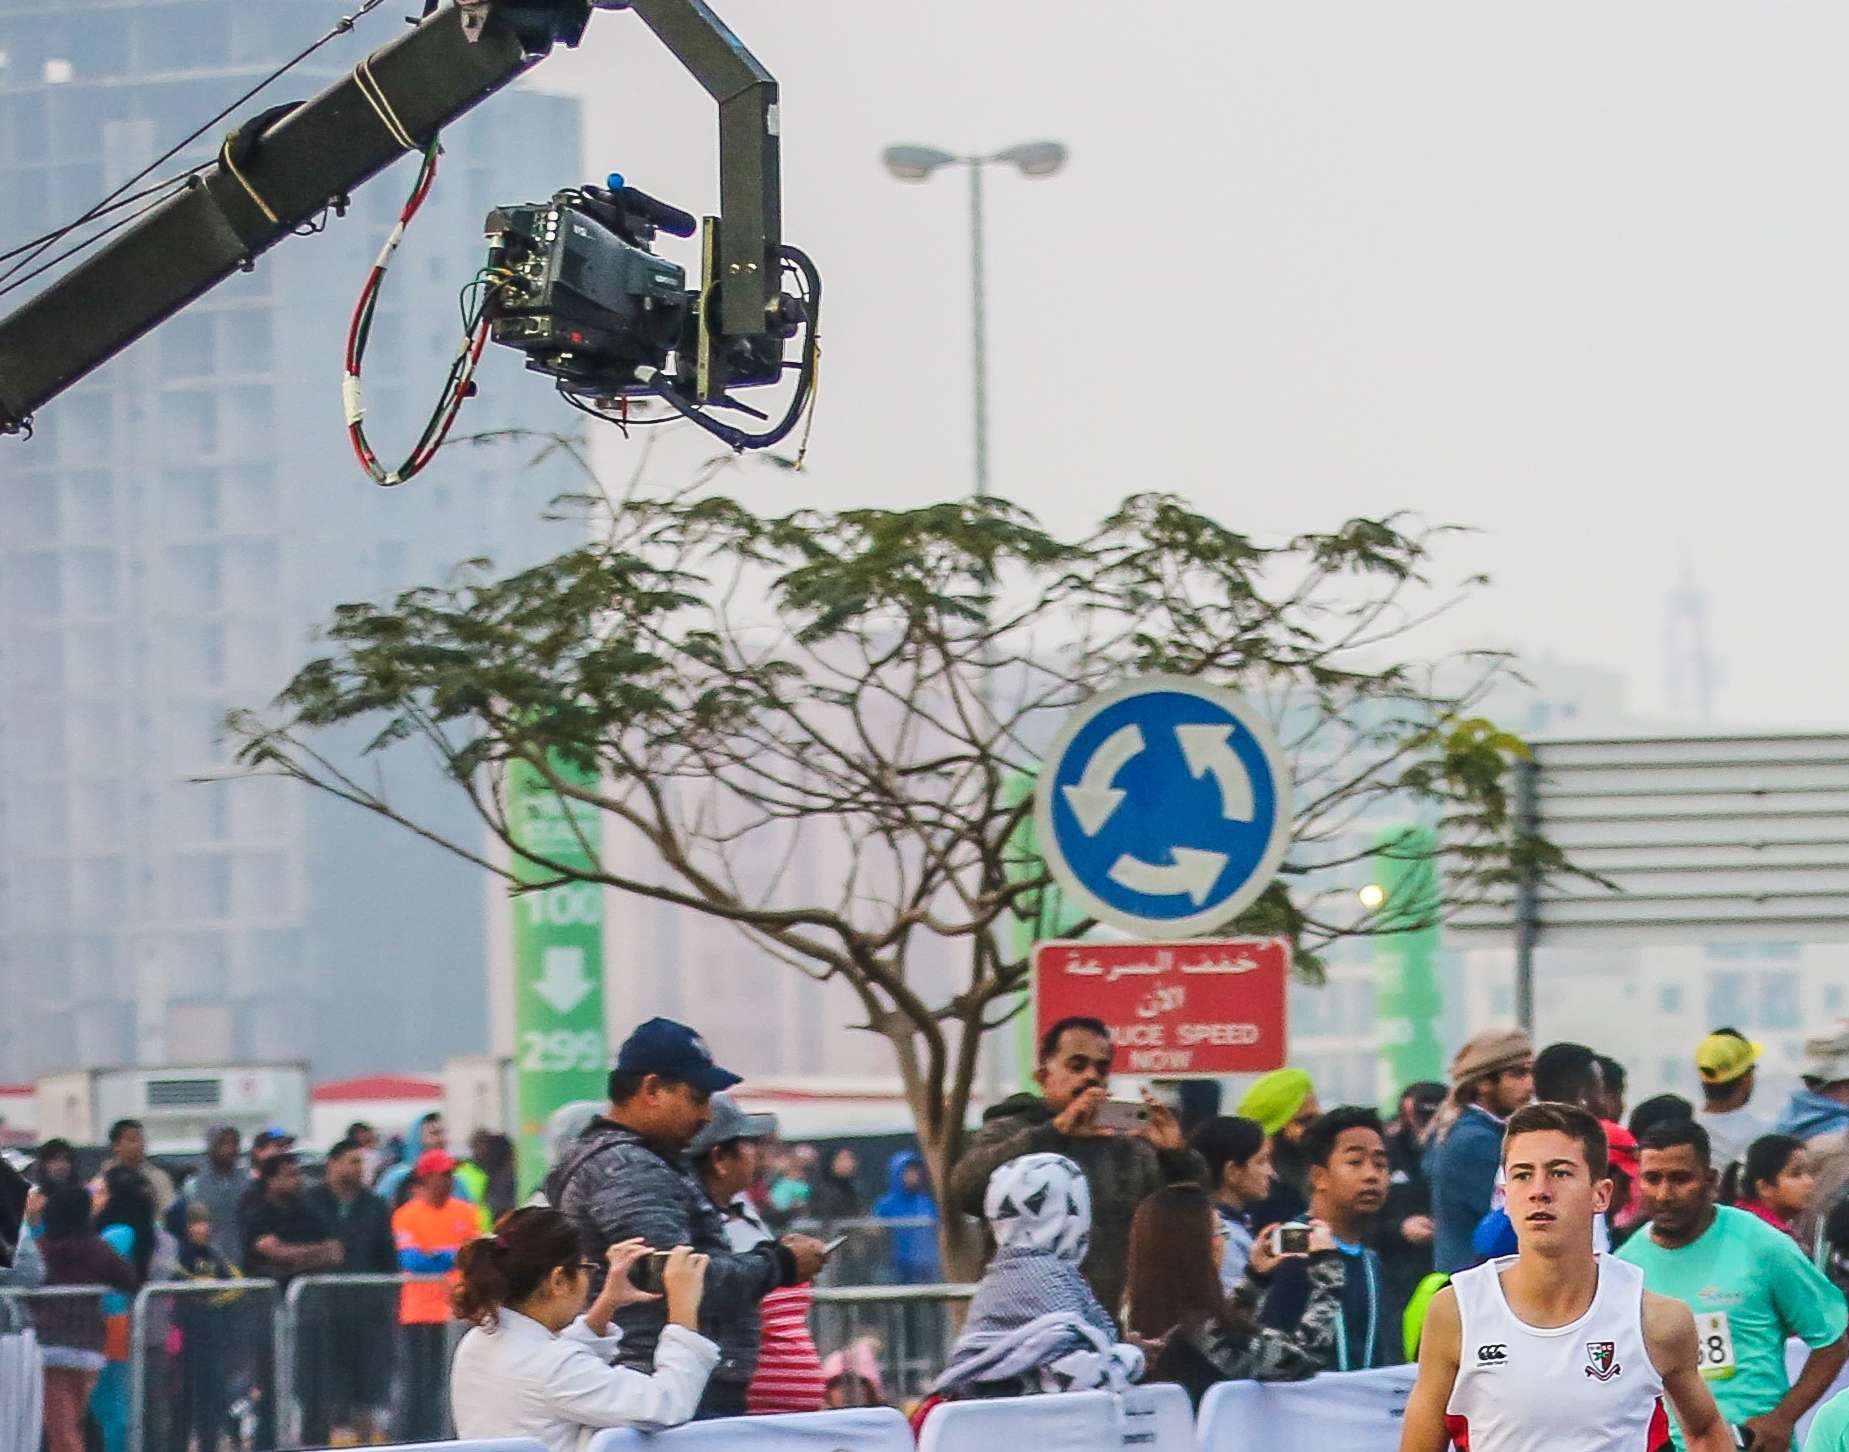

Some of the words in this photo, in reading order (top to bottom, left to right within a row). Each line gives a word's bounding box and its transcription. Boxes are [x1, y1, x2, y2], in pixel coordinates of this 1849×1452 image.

[1064, 950, 1173, 982] السرعة
[1176, 1024, 1260, 1045] SPEED
[1129, 1051, 1193, 1069] NOW
